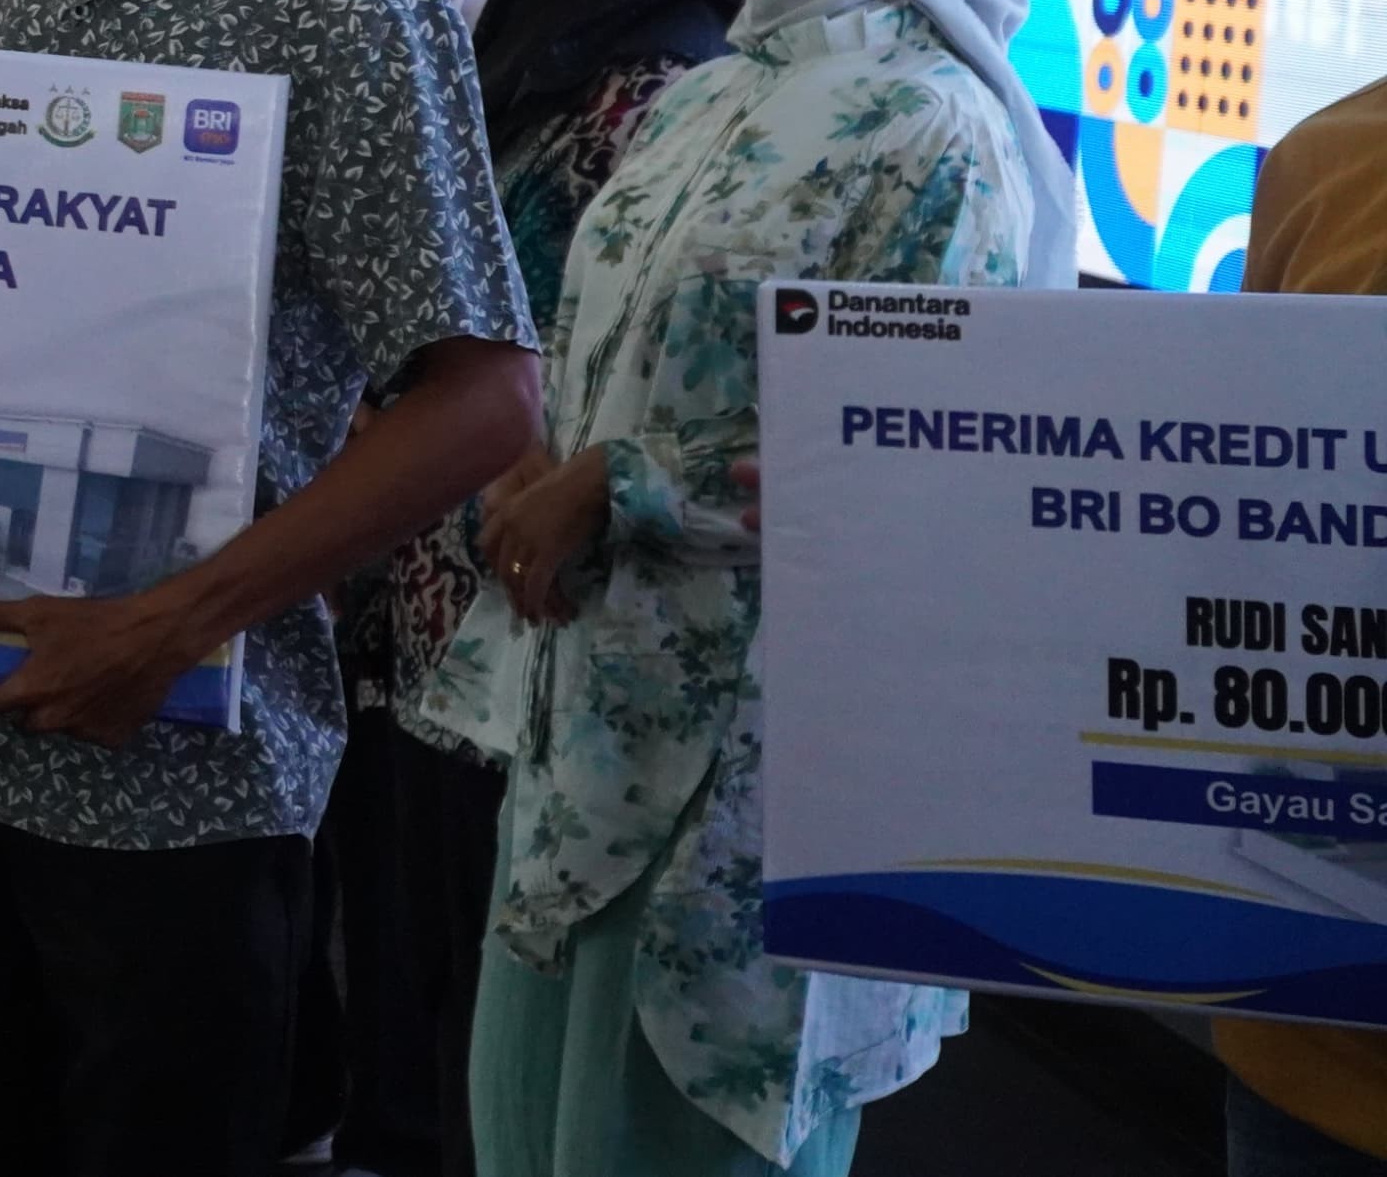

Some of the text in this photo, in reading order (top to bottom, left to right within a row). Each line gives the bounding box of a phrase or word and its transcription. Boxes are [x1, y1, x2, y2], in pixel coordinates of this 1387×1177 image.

[193, 109, 232, 131] BRI
[828, 290, 971, 316] Danantara
[828, 314, 962, 341] Indonesia
[841, 405, 1125, 460] PENERIMA
[1139, 419, 1348, 471] KREDIT
[1031, 486, 1121, 533] BRI
[1139, 493, 1221, 538] BO
[1185, 596, 1387, 660] RUDI SAN
[1107, 657, 1387, 739] Rp. 80.00
[1205, 780, 1335, 824] Gayau
